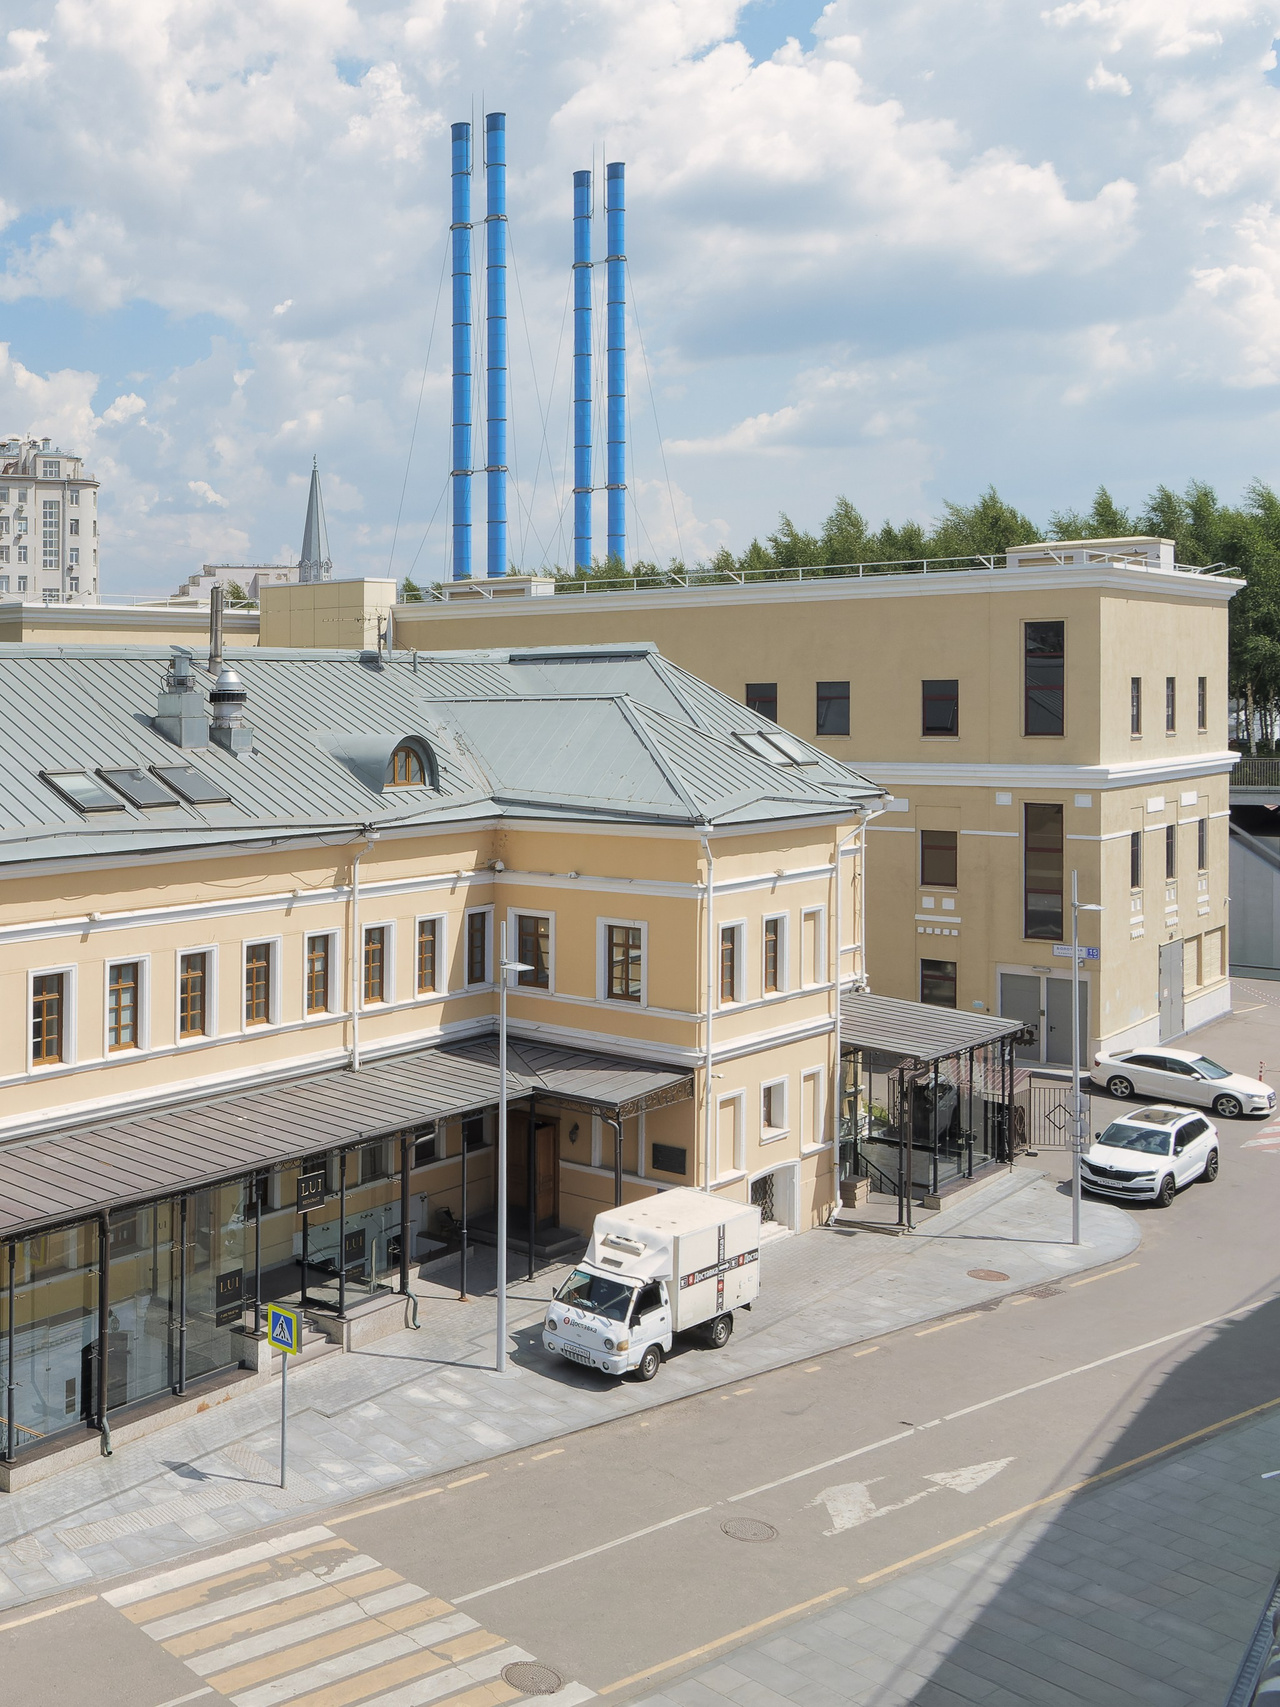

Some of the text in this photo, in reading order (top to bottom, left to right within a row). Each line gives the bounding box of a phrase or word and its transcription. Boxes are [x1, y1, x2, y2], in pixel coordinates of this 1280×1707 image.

[301, 1179, 322, 1196] LUI
[346, 1236, 363, 1251] LUI
[694, 1267, 719, 1284] Доставка
[220, 1276, 239, 1293] LUI
[570, 1319, 597, 1334] Доставка
